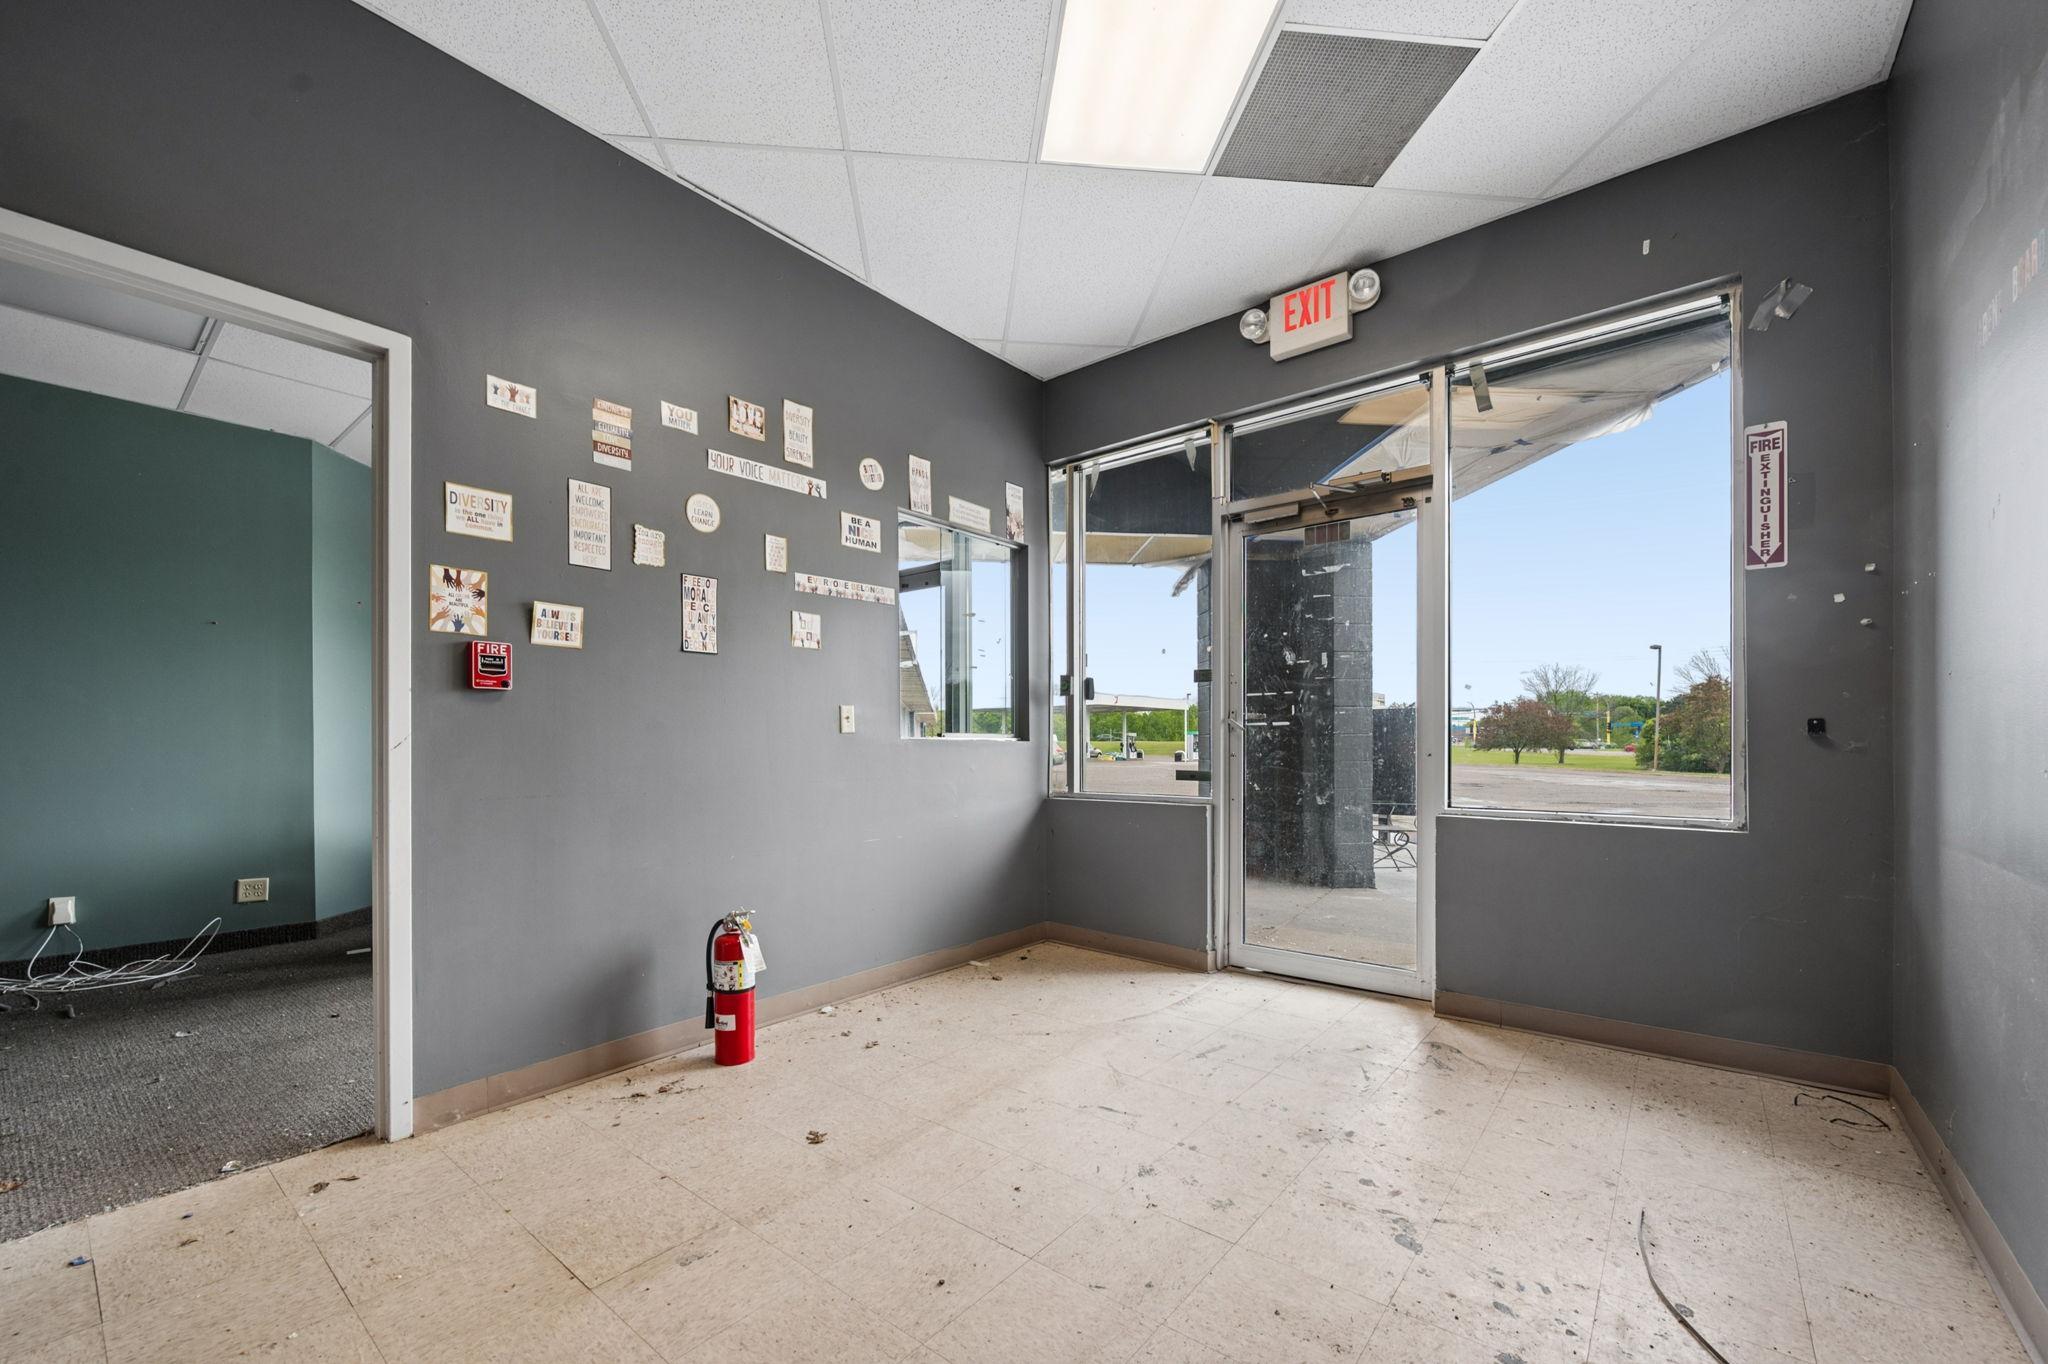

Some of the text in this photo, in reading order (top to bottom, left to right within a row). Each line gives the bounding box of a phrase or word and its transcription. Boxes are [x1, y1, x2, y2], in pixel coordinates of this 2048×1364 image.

[1284, 278, 1336, 333] EXIT
[667, 405, 693, 421] YOU
[788, 430, 808, 444] BEAUTY
[597, 444, 630, 459] DIVERSITY
[1750, 437, 1781, 454] FIRE
[786, 447, 812, 463] STRENGTH
[710, 452, 806, 492] YOUR VOICE MATTERS
[577, 484, 588, 495] ALL
[449, 491, 508, 514] DIVERSITY
[575, 495, 606, 510] WELCOME
[1760, 453, 1772, 557] EXTINGUISHER
[462, 508, 473, 516] the
[474, 511, 487, 519] one
[466, 516, 480, 524] ALL
[571, 505, 609, 522] EMPOWERED
[693, 508, 714, 519] LEARN
[571, 517, 609, 534] ENCOURAGED
[691, 515, 716, 528] CHANGE
[850, 516, 872, 529] BE A
[573, 530, 607, 545] IMPORTANT
[848, 524, 875, 540] NICE
[573, 540, 607, 556] RESPECTED
[845, 535, 878, 550] HUMAN
[807, 575, 886, 596] EVERYONE BELONGS
[541, 608, 576, 622] ALWAYS
[684, 602, 716, 613] PEACE
[536, 618, 580, 633] BELIEVE IN
[537, 629, 579, 643] YOURSELF
[684, 630, 716, 642] LOVE
[477, 643, 508, 655] FIRE
